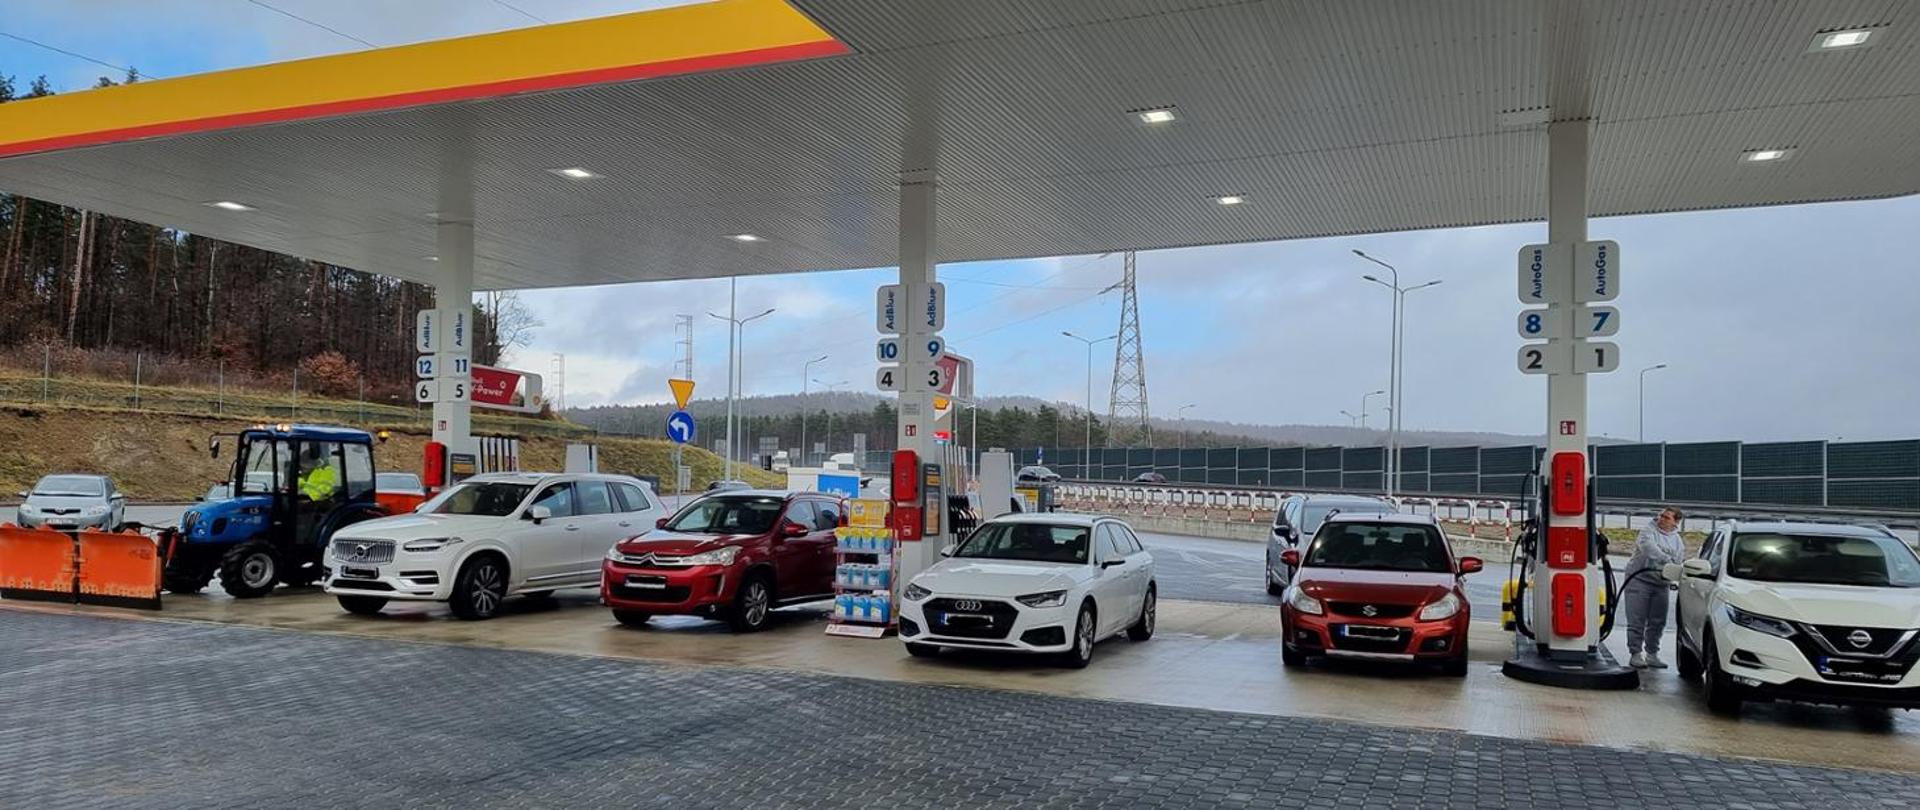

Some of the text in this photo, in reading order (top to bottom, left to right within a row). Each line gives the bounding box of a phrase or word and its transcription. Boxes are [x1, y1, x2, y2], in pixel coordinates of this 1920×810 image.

[1531, 249, 1542, 298] AutoGas
[1595, 245, 1606, 295] AutoGas
[885, 288, 895, 330] AdBlue
[926, 286, 937, 327] AdBlue
[455, 311, 463, 347] AdBlue
[1525, 314, 1541, 334] 8
[1593, 312, 1611, 331] 7
[423, 315, 431, 348] AdBlue
[879, 343, 897, 358] 10
[927, 341, 940, 357] 9
[1595, 348, 1604, 368] 1
[418, 360, 432, 374] 12
[455, 359, 467, 373] 11
[1526, 350, 1542, 369] 2
[881, 371, 893, 387] 4
[928, 370, 940, 387] 3
[420, 385, 428, 399] 6
[455, 384, 464, 398] 5
